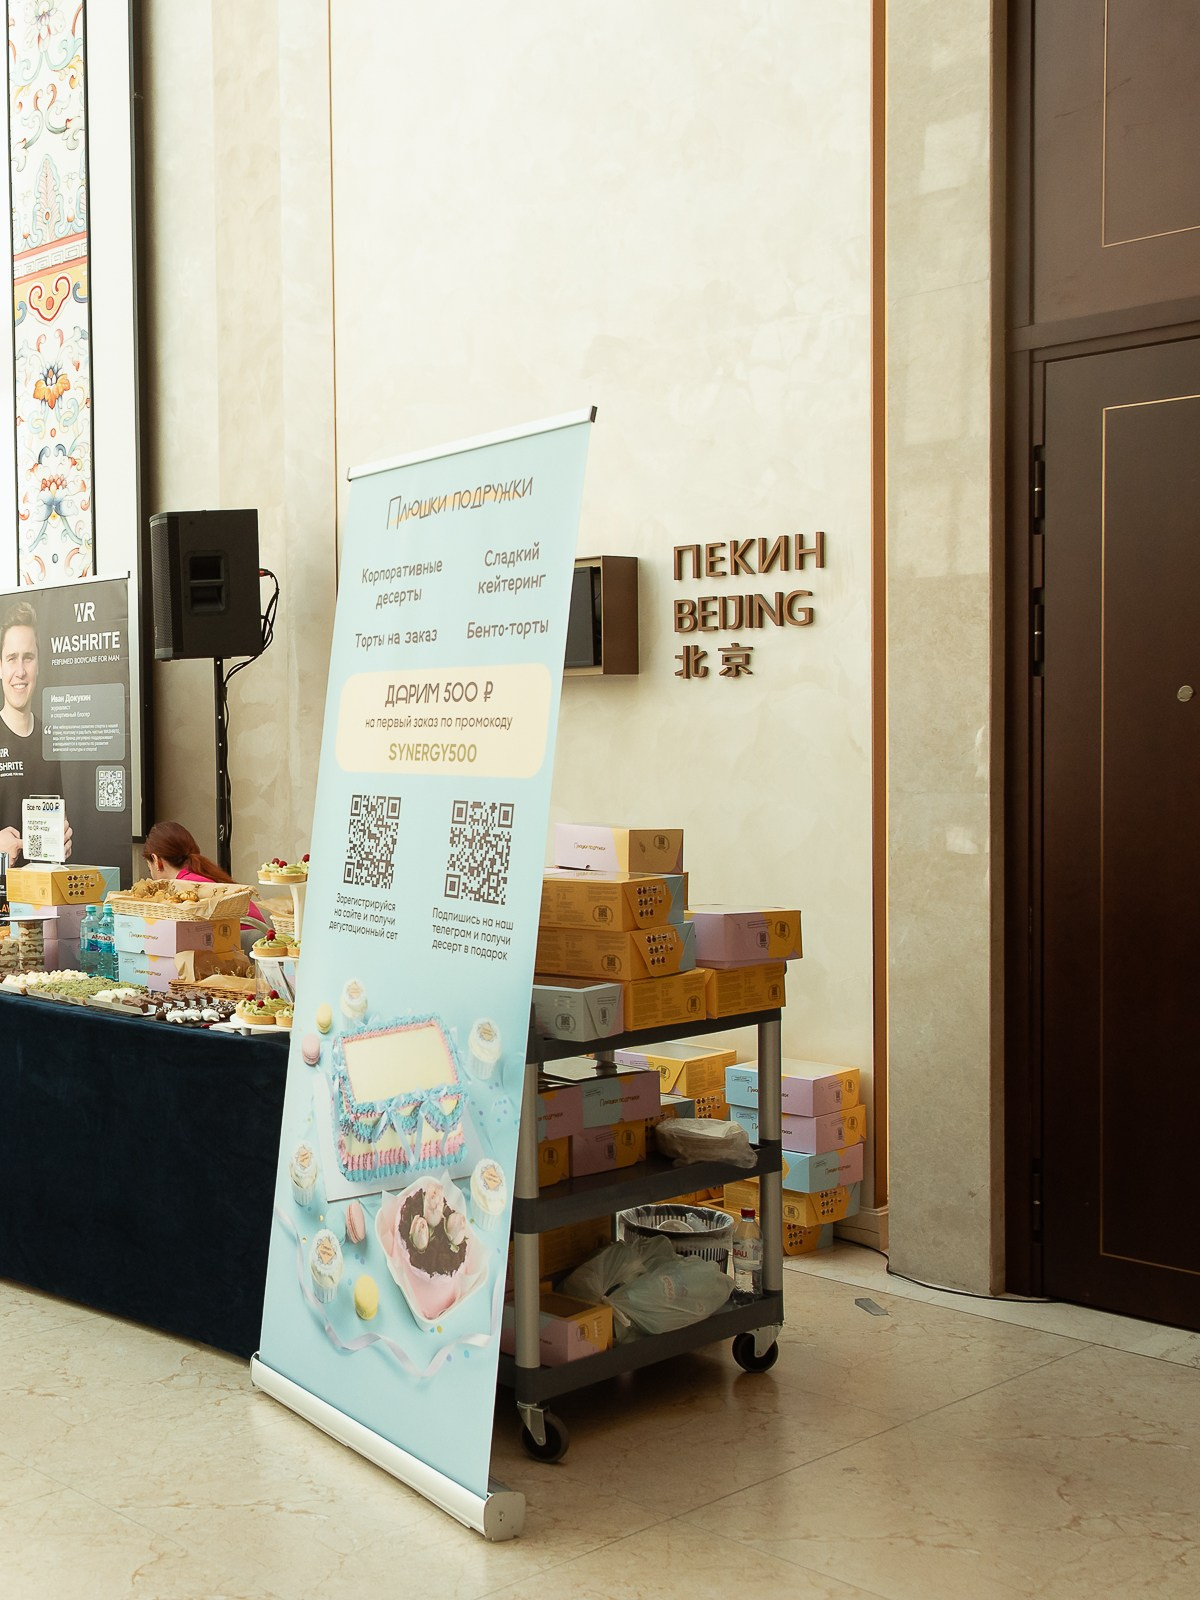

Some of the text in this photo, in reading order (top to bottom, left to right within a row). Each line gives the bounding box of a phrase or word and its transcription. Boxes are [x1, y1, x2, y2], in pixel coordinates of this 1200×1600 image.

[386, 477, 534, 530] Плюшки подружки
[484, 541, 540, 570] Сладкий
[673, 531, 825, 581] ПЕКИН
[361, 559, 443, 585] Корпоративные
[478, 572, 546, 595] кейтеринг
[375, 587, 422, 609] десерты
[673, 589, 814, 633] BEIJING
[355, 628, 438, 651] Торты на заказ
[466, 618, 549, 639] Бенто-торты
[50, 631, 121, 654] WASHRITE
[674, 642, 754, 680] 北京
[384, 682, 440, 707] ДАРИМ
[443, 681, 478, 703] 500
[365, 715, 513, 731] на первый заказ по промокоду
[388, 743, 477, 763] SYNERGY500
[336, 892, 396, 912] Зарегистрируйся
[334, 908, 342, 917] на
[342, 909, 362, 921] сайте
[369, 914, 396, 926] получи
[432, 907, 514, 931] Подпишись на наш
[329, 920, 398, 941] дегустационный сет
[432, 923, 511, 946] телеграм и получи
[432, 938, 508, 961] десерт в подарок
